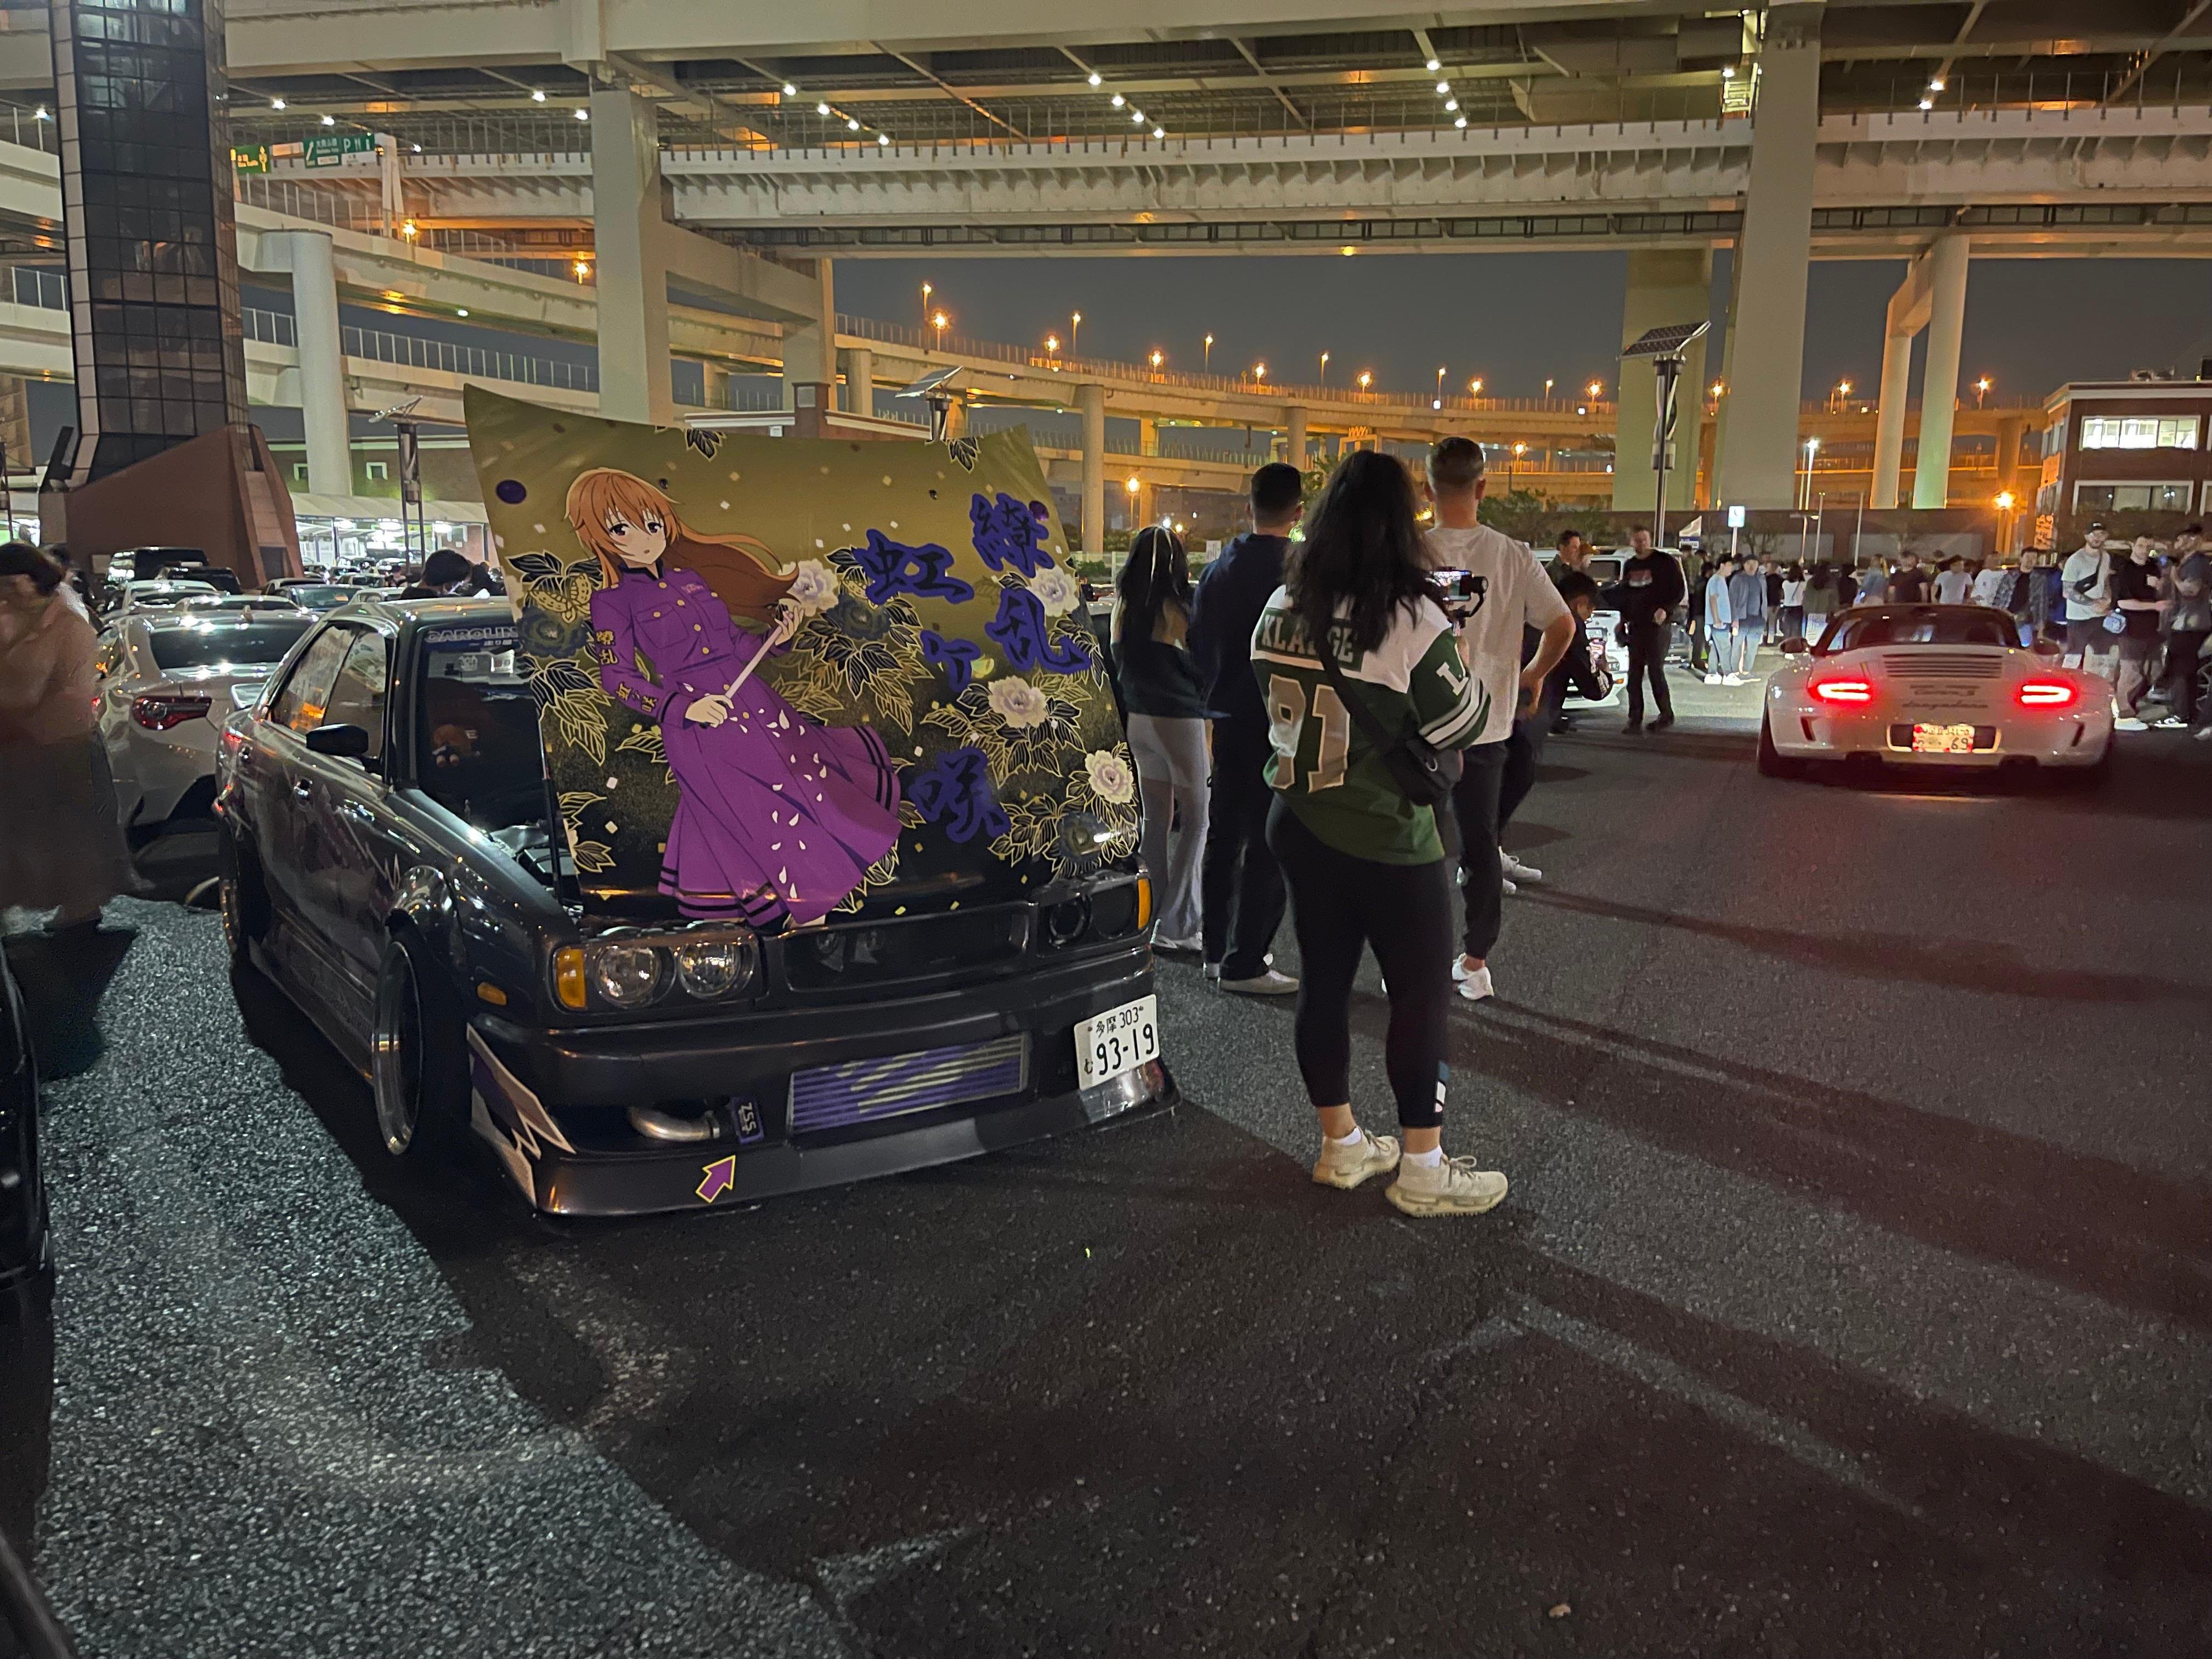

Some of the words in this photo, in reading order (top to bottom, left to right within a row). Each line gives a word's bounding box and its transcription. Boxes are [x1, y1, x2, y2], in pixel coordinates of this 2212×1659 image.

[1096, 1015, 1117, 1038] 多摩
[1119, 1007, 1139, 1029] 303
[1096, 1023, 1154, 1076] 93-19
